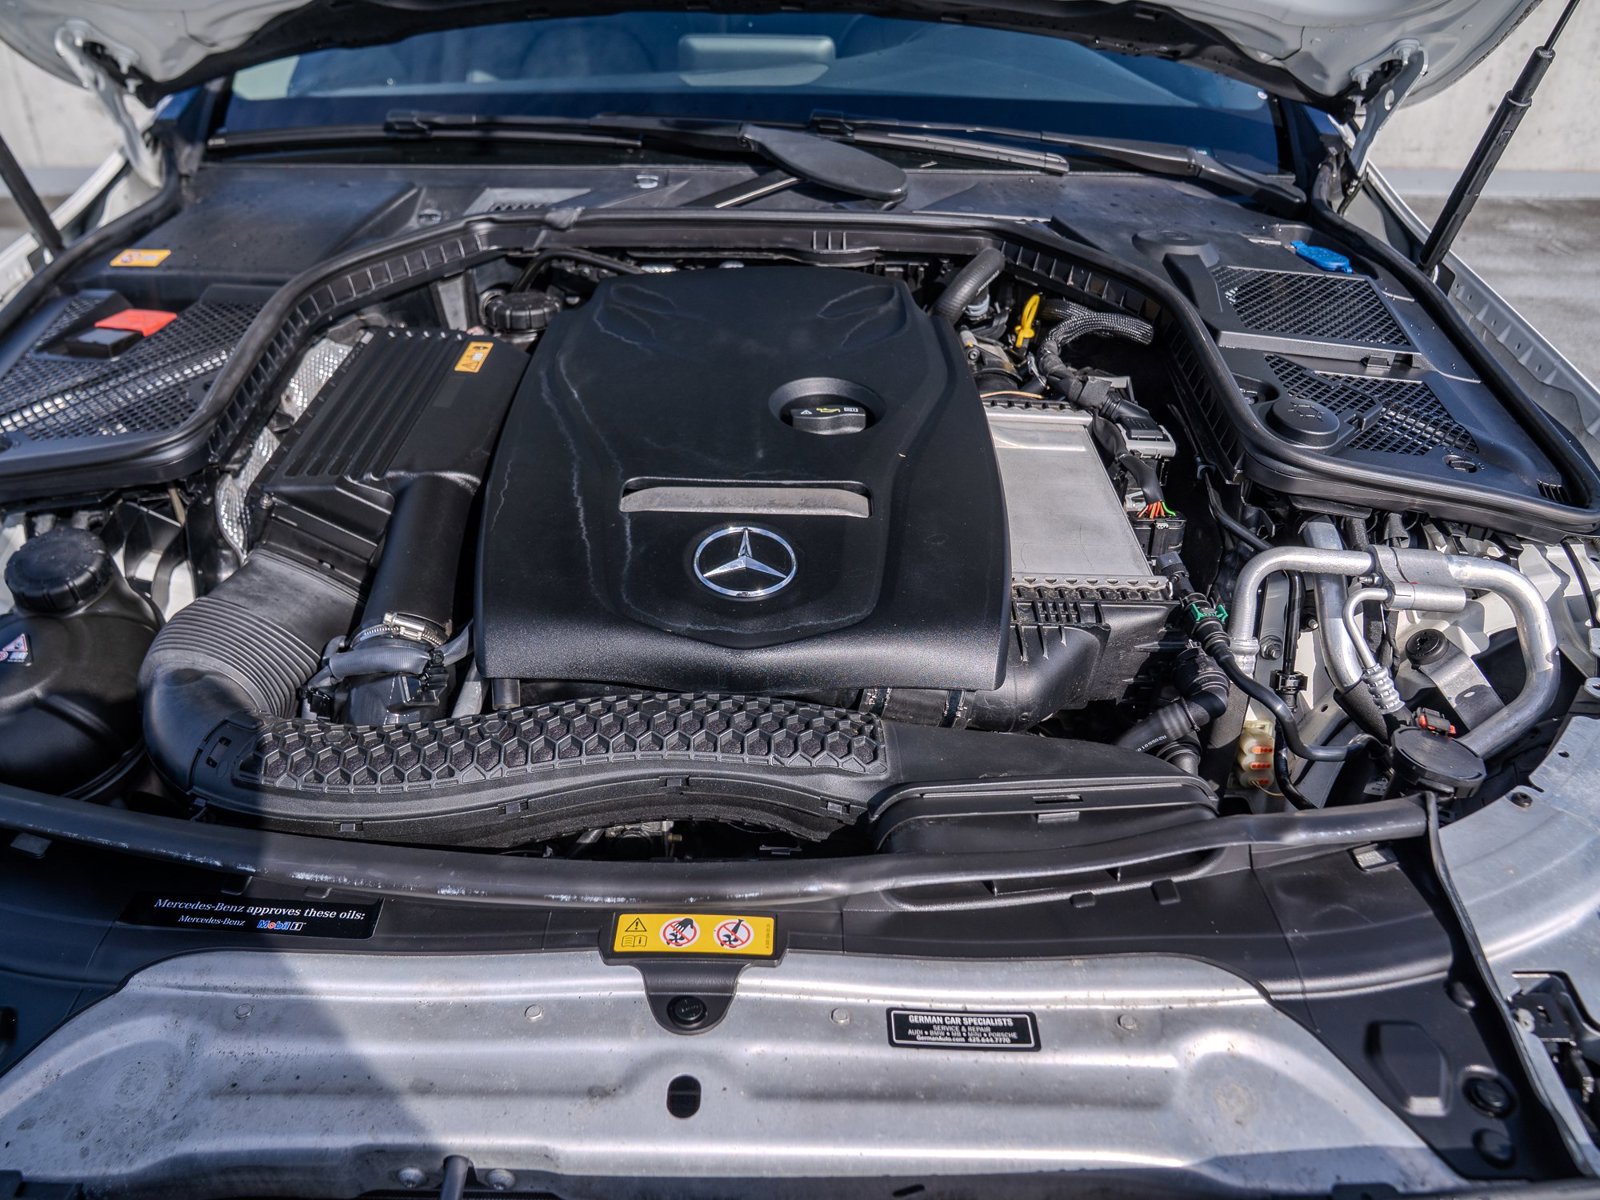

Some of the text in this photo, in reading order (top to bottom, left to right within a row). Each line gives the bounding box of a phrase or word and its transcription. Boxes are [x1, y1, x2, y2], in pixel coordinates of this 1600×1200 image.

[154, 898, 366, 920] Mercedes-Benz approves these oils:
[178, 915, 246, 926] Mercedes-Benz
[257, 920, 291, 930] Mobil
[908, 1015, 1014, 1026] GERMAN CAR SPECIALISTS
